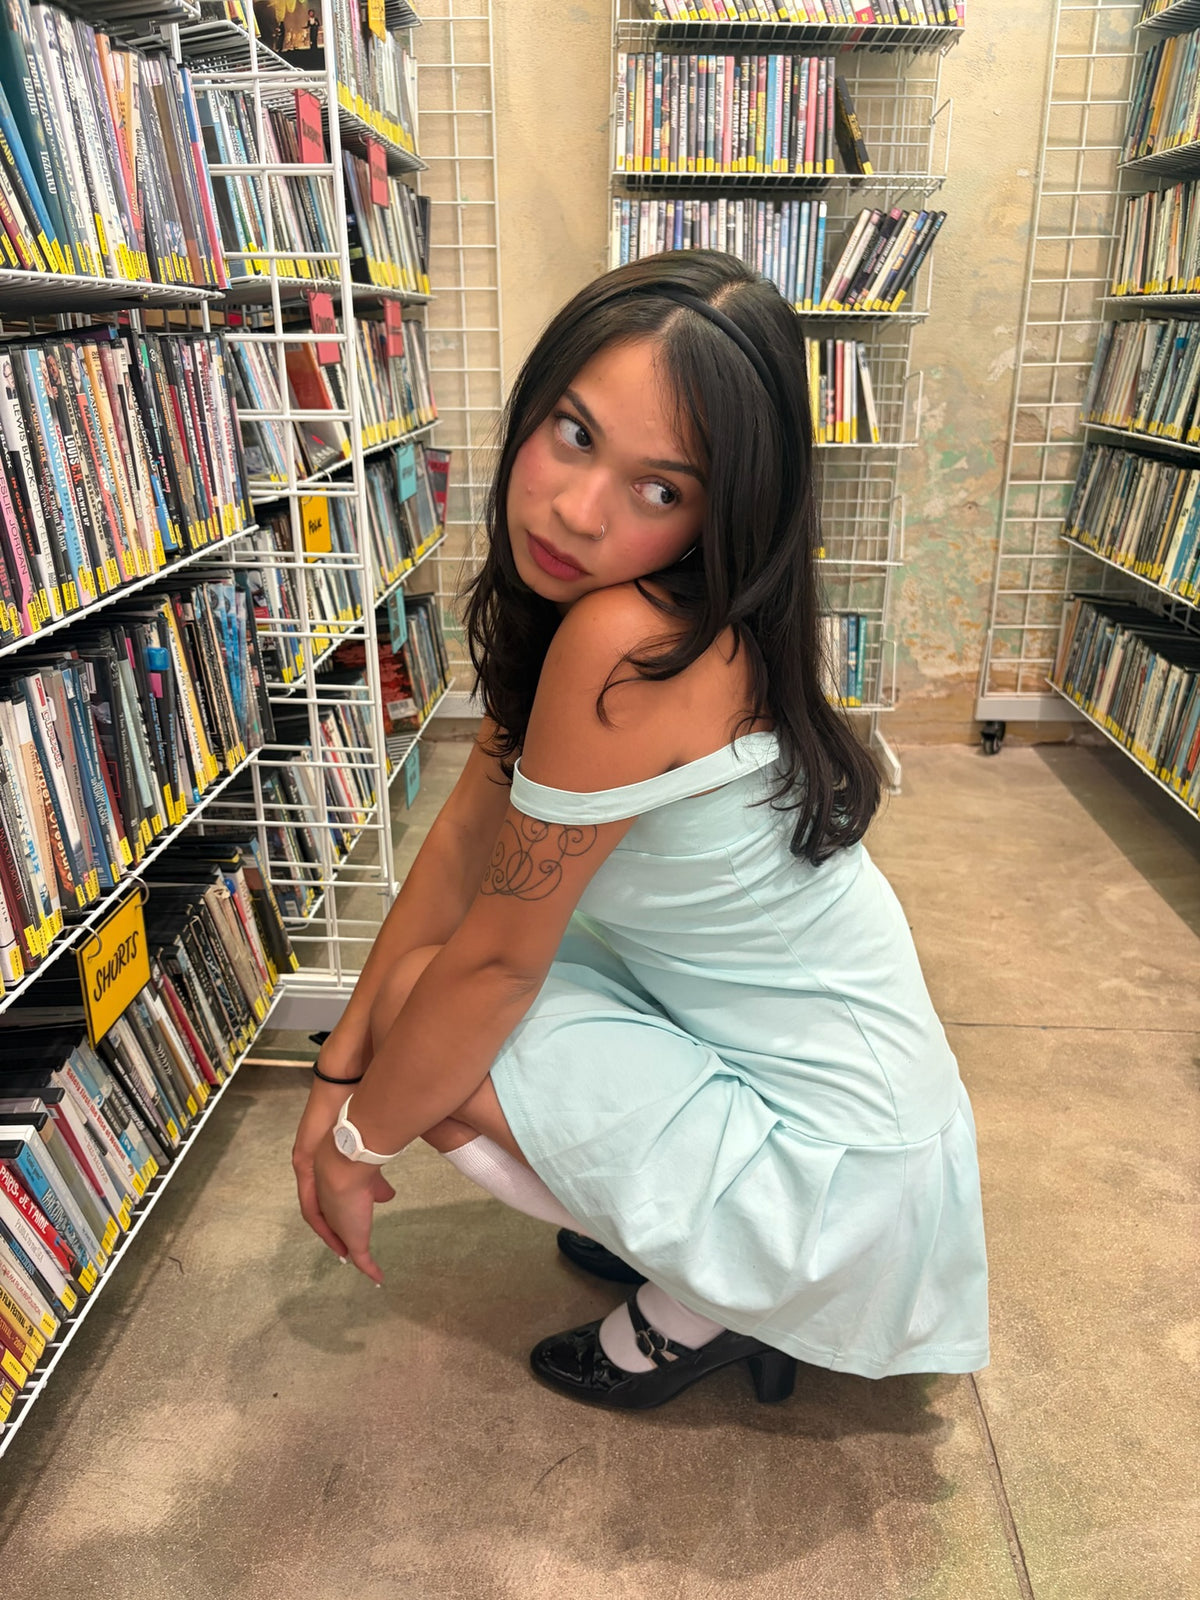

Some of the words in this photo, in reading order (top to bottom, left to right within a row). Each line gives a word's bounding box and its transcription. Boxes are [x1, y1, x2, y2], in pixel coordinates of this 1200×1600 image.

[26, 53, 41, 90] EDDIE
[36, 91, 53, 136] IZZARD
[784, 57, 792, 80] PETER
[22, 76, 39, 116] EDDIE
[39, 150, 57, 195] IZZARD
[35, 52, 56, 113] EDDIE
[51, 117, 74, 186] IZZARD
[731, 104, 740, 147] MARLEY
[738, 89, 749, 140] MARLEY
[76, 128, 86, 154] KNOW
[90, 191, 99, 211] YOU
[90, 122, 99, 143] THE
[96, 146, 114, 205] DISABLED
[35, 366, 47, 400] LISA
[42, 402, 67, 488] LAMPANELLI
[86, 385, 107, 454] MARGARET
[104, 458, 115, 485] CHO
[155, 372, 163, 392] NORM
[160, 394, 172, 436] MACDONALD
[55, 424, 65, 453] LOUIE
[61, 455, 76, 505] ANDERSON
[62, 385, 76, 425] Louis
[73, 429, 85, 460] C.K.
[84, 474, 104, 540] Hilarious
[64, 434, 78, 465] LOUIS
[70, 463, 83, 484] C.K.
[82, 404, 103, 468] MARGARET
[99, 467, 109, 491] CHO
[136, 414, 157, 472] McDONALD
[153, 428, 162, 454] lawrence
[162, 476, 170, 493] crazy
[0, 433, 12, 468] BLACK
[10, 476, 17, 489] IN
[14, 491, 23, 512] GOD
[20, 515, 28, 530] WE
[24, 532, 35, 556] RUST
[12, 403, 26, 441] LEWIS
[21, 445, 35, 487] BLACK:
[31, 490, 42, 518] OLD
[38, 522, 53, 567] YELLER
[30, 403, 40, 433] LEWIS
[36, 434, 46, 462] BLACK
[43, 466, 53, 493] stark
[56, 525, 67, 552] BLACK
[38, 484, 51, 518] screwed
[75, 486, 87, 516] CHEWED
[121, 486, 129, 507] WANT
[8, 519, 27, 575] JORDAN
[83, 517, 89, 526] UP
[148, 693, 157, 721] French
[28, 744, 39, 780] CINEMA
[120, 730, 128, 752] Death
[124, 763, 132, 788] Tempo
[30, 749, 52, 806] Carpet
[48, 810, 74, 881] Creature
[71, 764, 79, 785] Media
[75, 787, 85, 818] Academy
[27, 839, 41, 874] mix
[93, 931, 139, 1002] SHORTS
[64, 1067, 83, 1091] Safety
[88, 1104, 100, 1117] the
[95, 1115, 108, 1130] Rise
[0, 1165, 23, 1199] PARIS,
[17, 1193, 31, 1207] JE
[24, 1203, 52, 1234] T'AIME
[12, 1218, 30, 1240] PADDLE
[32, 1248, 45, 1263] SEA
[8, 1304, 29, 1327] FESTIVAL
